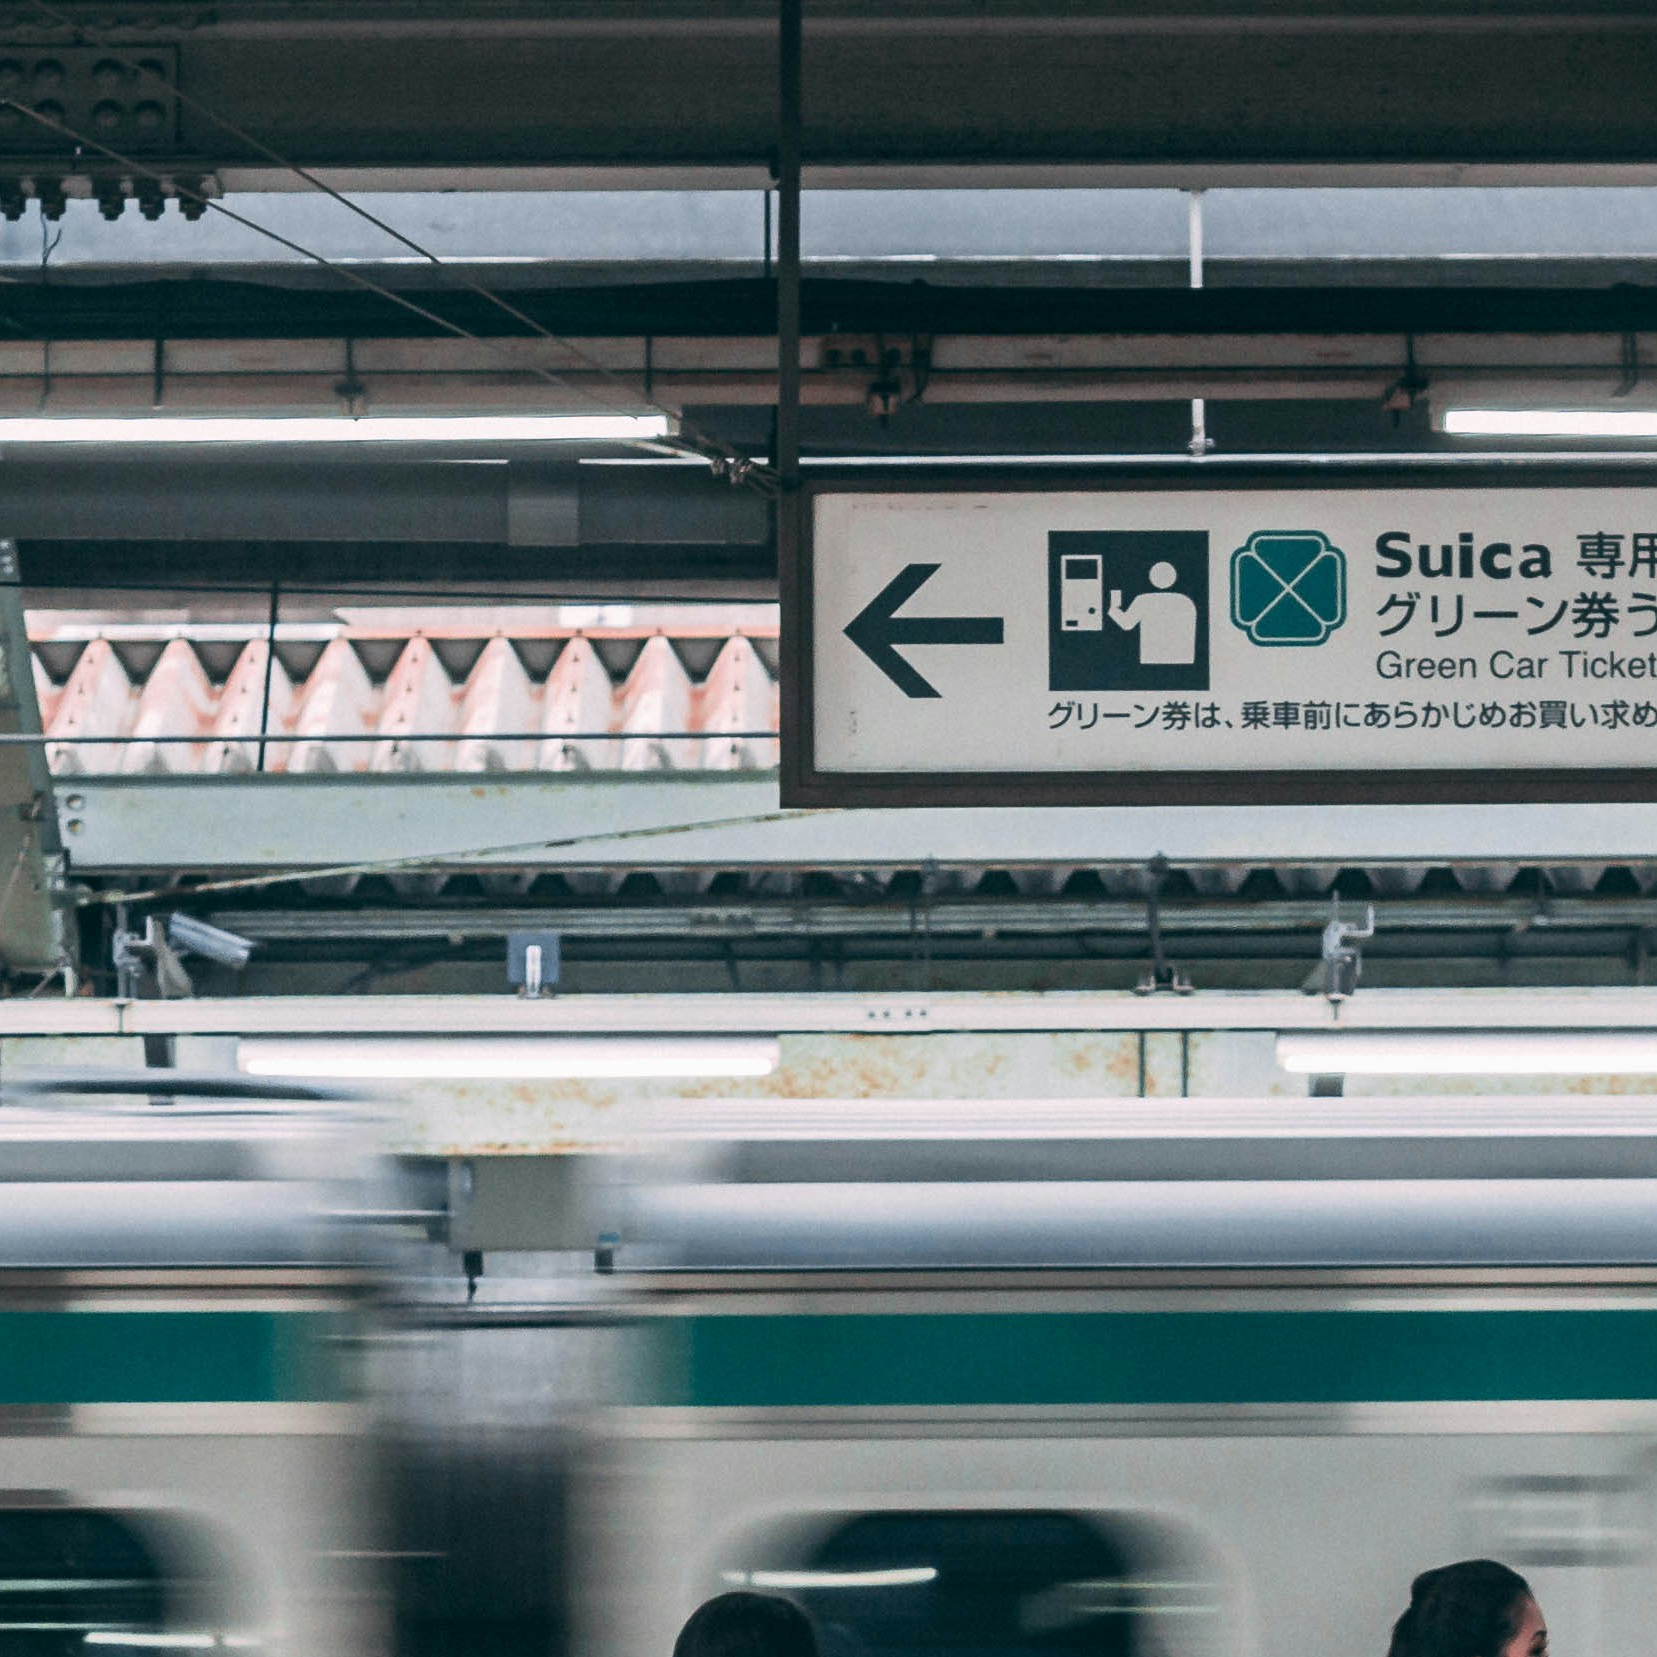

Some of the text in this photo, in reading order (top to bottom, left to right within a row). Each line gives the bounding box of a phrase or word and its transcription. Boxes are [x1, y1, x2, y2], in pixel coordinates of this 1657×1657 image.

[1375, 531, 1552, 580] Suica
[1376, 651, 1477, 679] Green
[1489, 651, 1548, 679] Car
